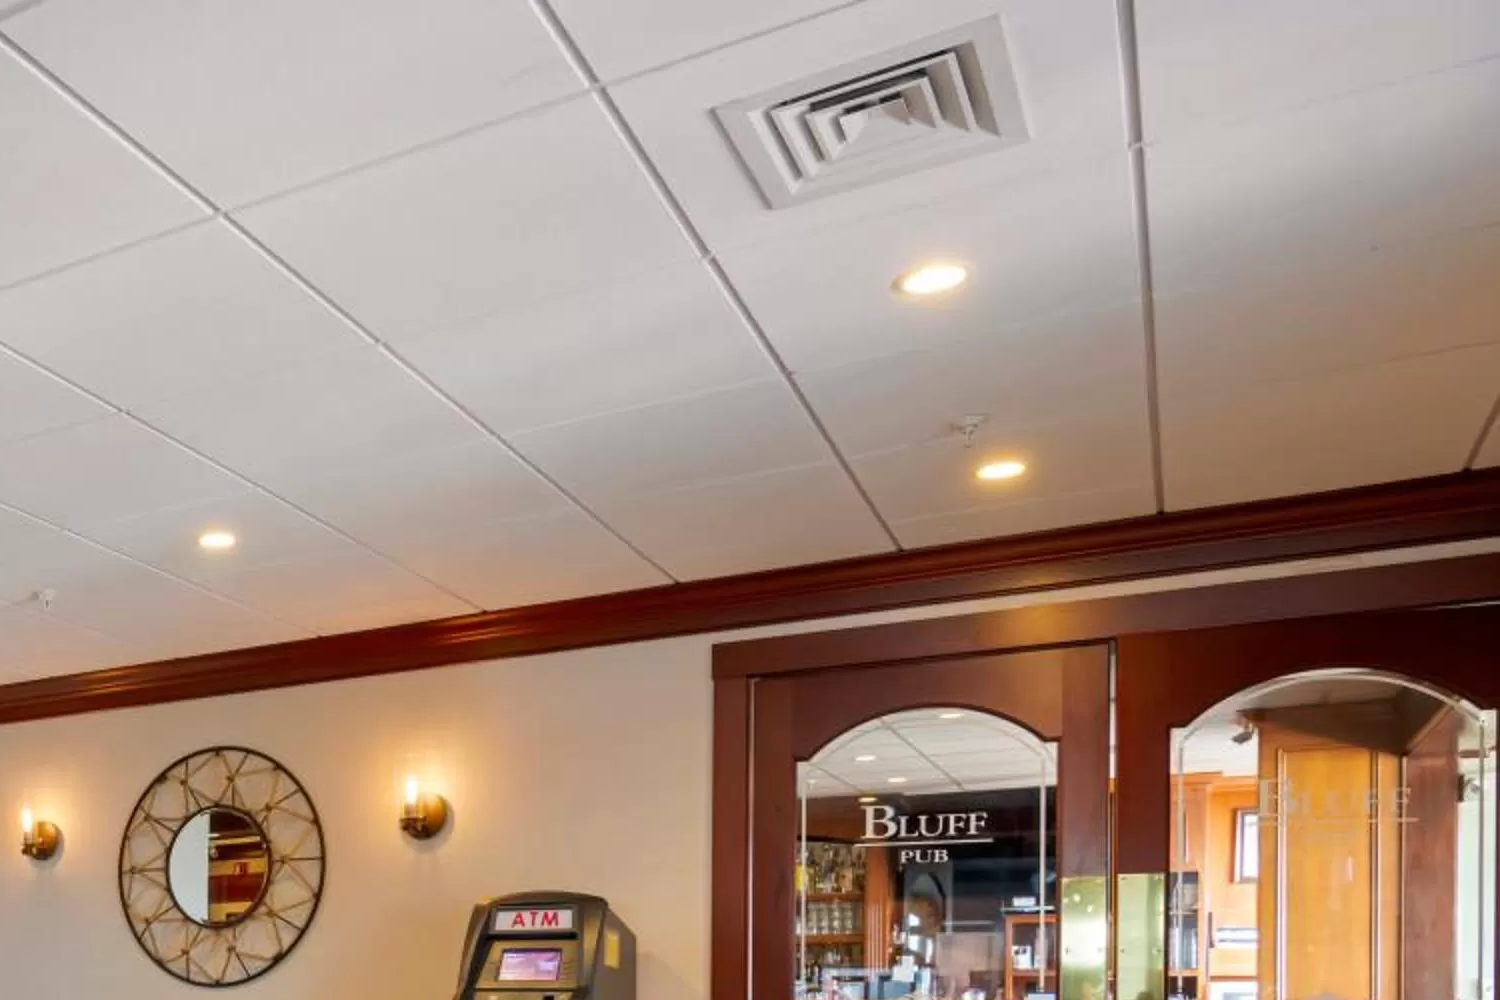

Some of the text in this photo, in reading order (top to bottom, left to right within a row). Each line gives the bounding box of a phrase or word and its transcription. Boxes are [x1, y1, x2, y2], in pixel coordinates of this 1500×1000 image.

[860, 803, 989, 840] BLUFF
[901, 849, 949, 864] PUB
[510, 909, 560, 928] ATM
